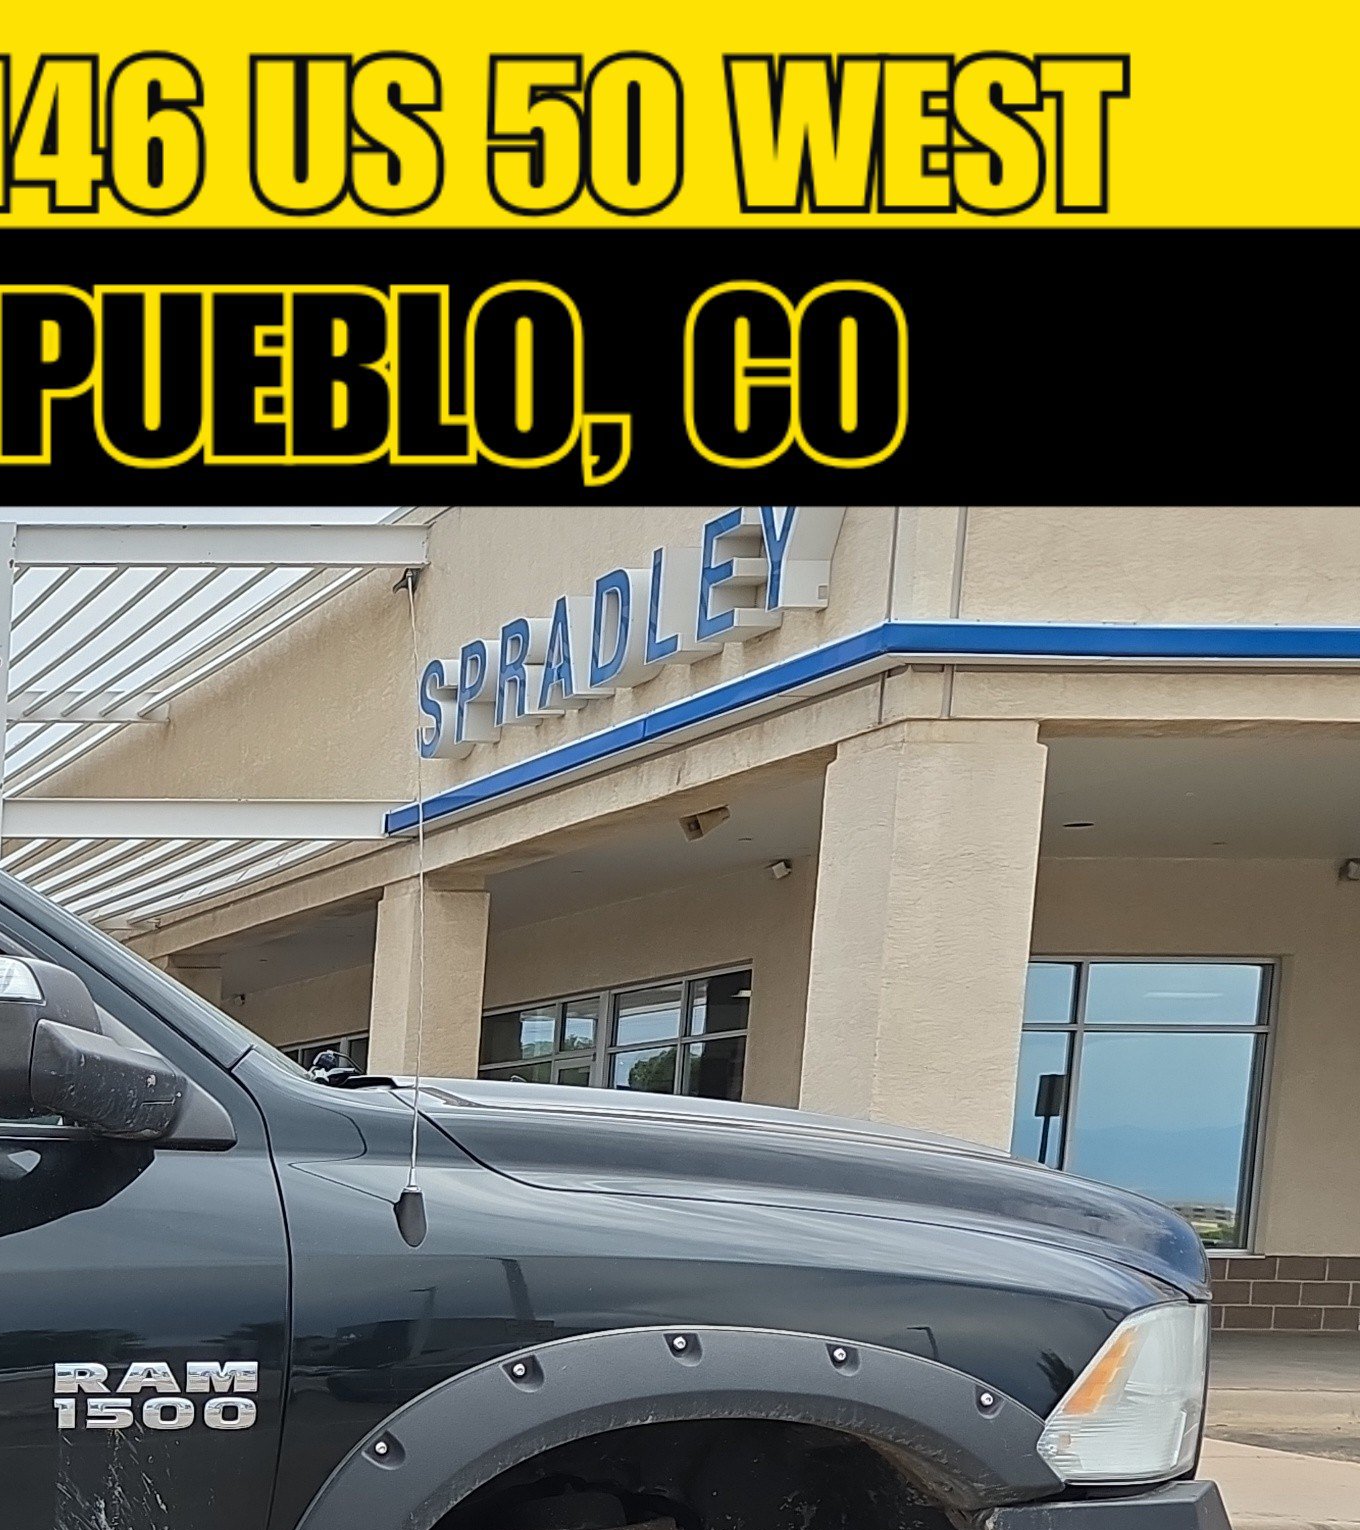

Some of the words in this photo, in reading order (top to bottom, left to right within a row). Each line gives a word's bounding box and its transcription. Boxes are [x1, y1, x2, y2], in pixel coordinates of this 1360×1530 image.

[417, 506, 798, 760] SPRADLEY
[53, 1360, 259, 1394] RAM
[53, 1396, 258, 1430] 1500
